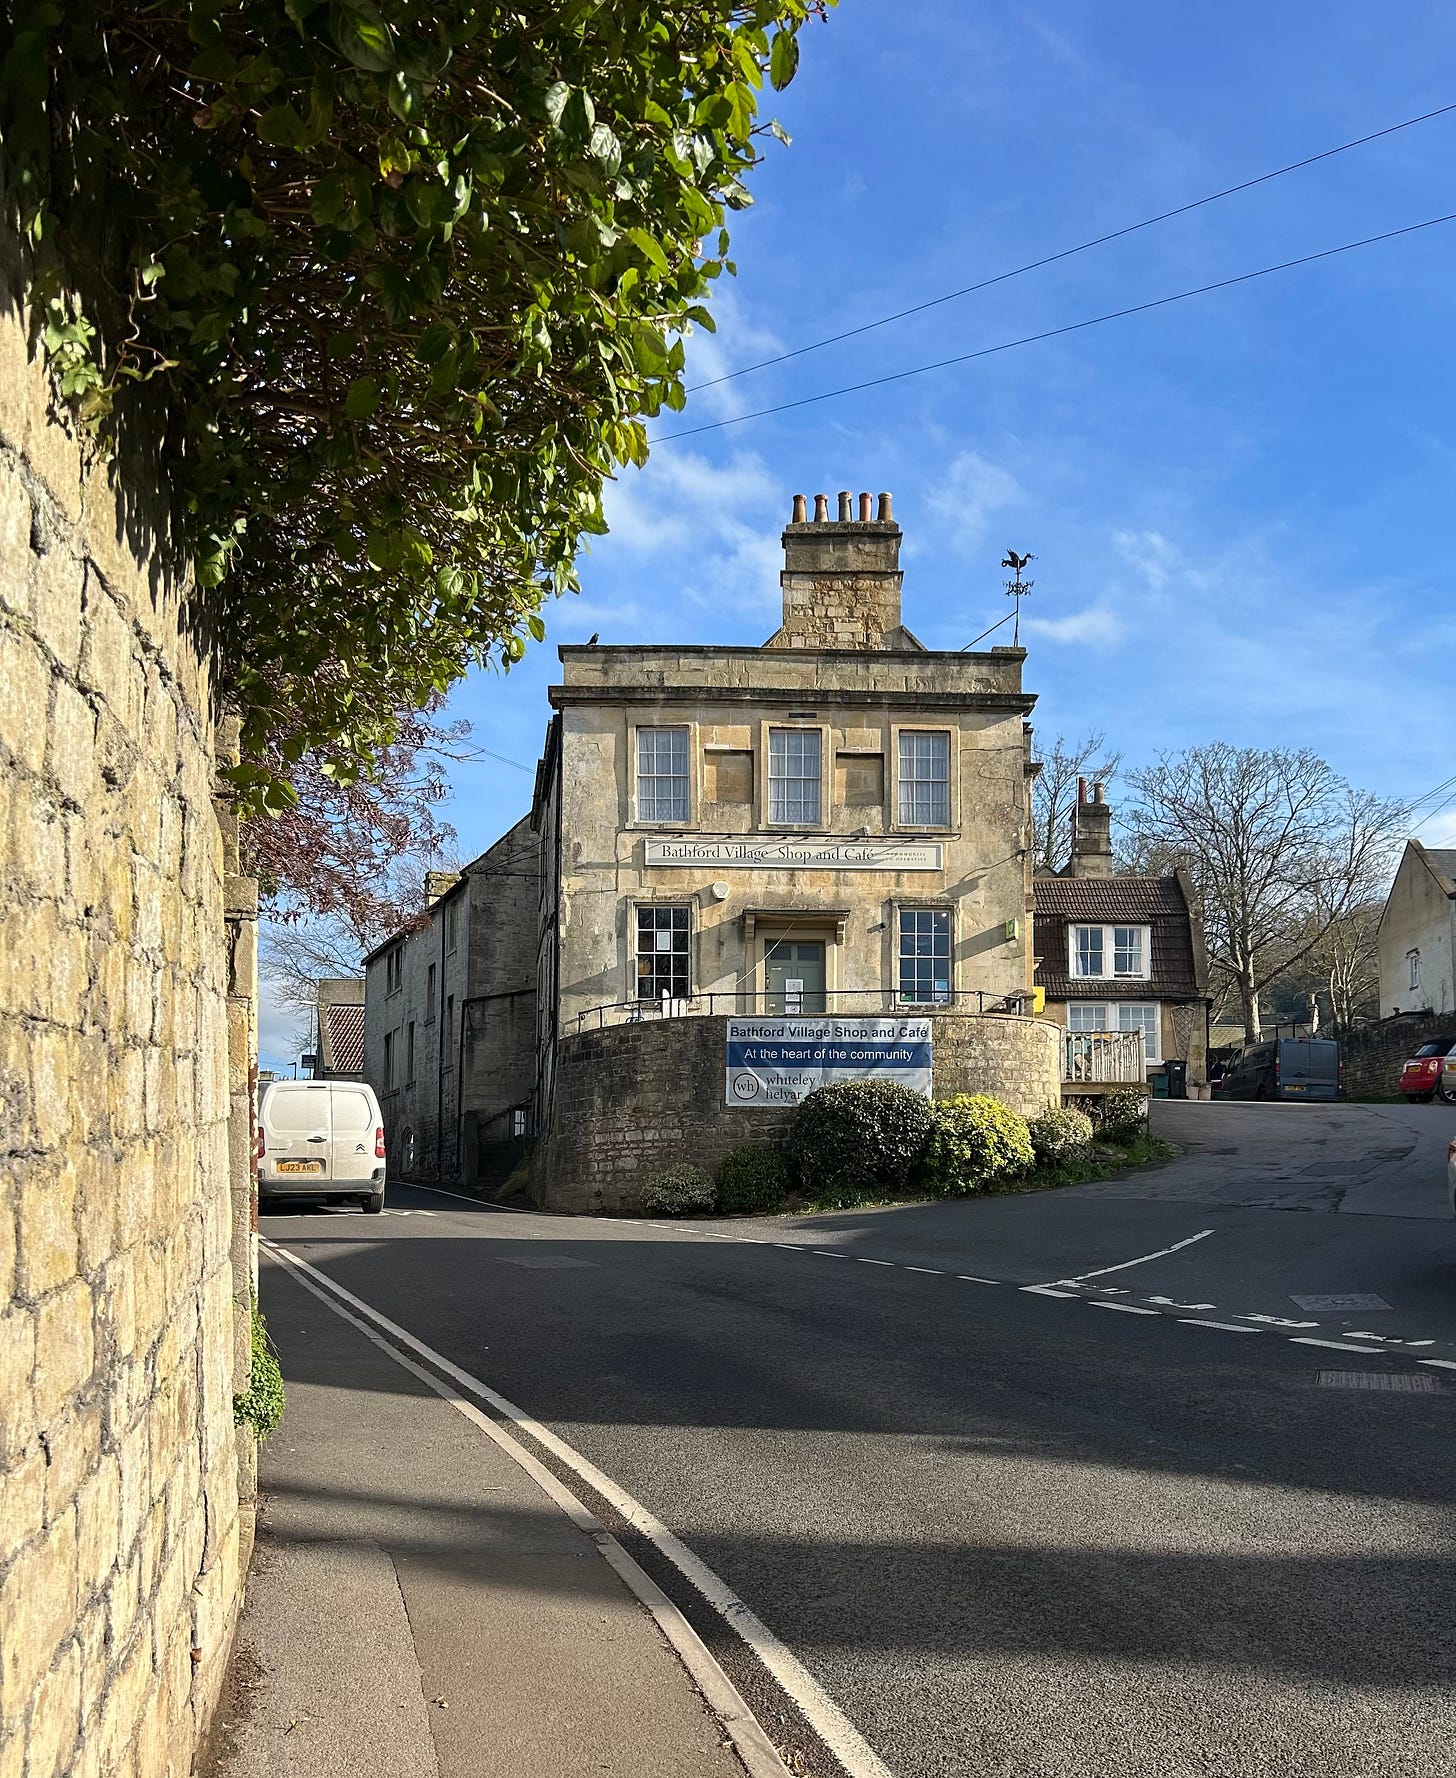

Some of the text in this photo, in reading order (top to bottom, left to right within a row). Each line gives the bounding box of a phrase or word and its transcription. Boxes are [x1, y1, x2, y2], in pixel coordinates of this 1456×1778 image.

[662, 844, 874, 865] Bathford Village Shop and Café
[730, 1025, 928, 1040] Bathford Village Shop and Café
[744, 1048, 913, 1062] At the heart of the community
[736, 1079, 754, 1092] wh
[766, 1073, 816, 1089] whiteley
[766, 1087, 803, 1103] helyar
[280, 1163, 300, 1172] LJ23
